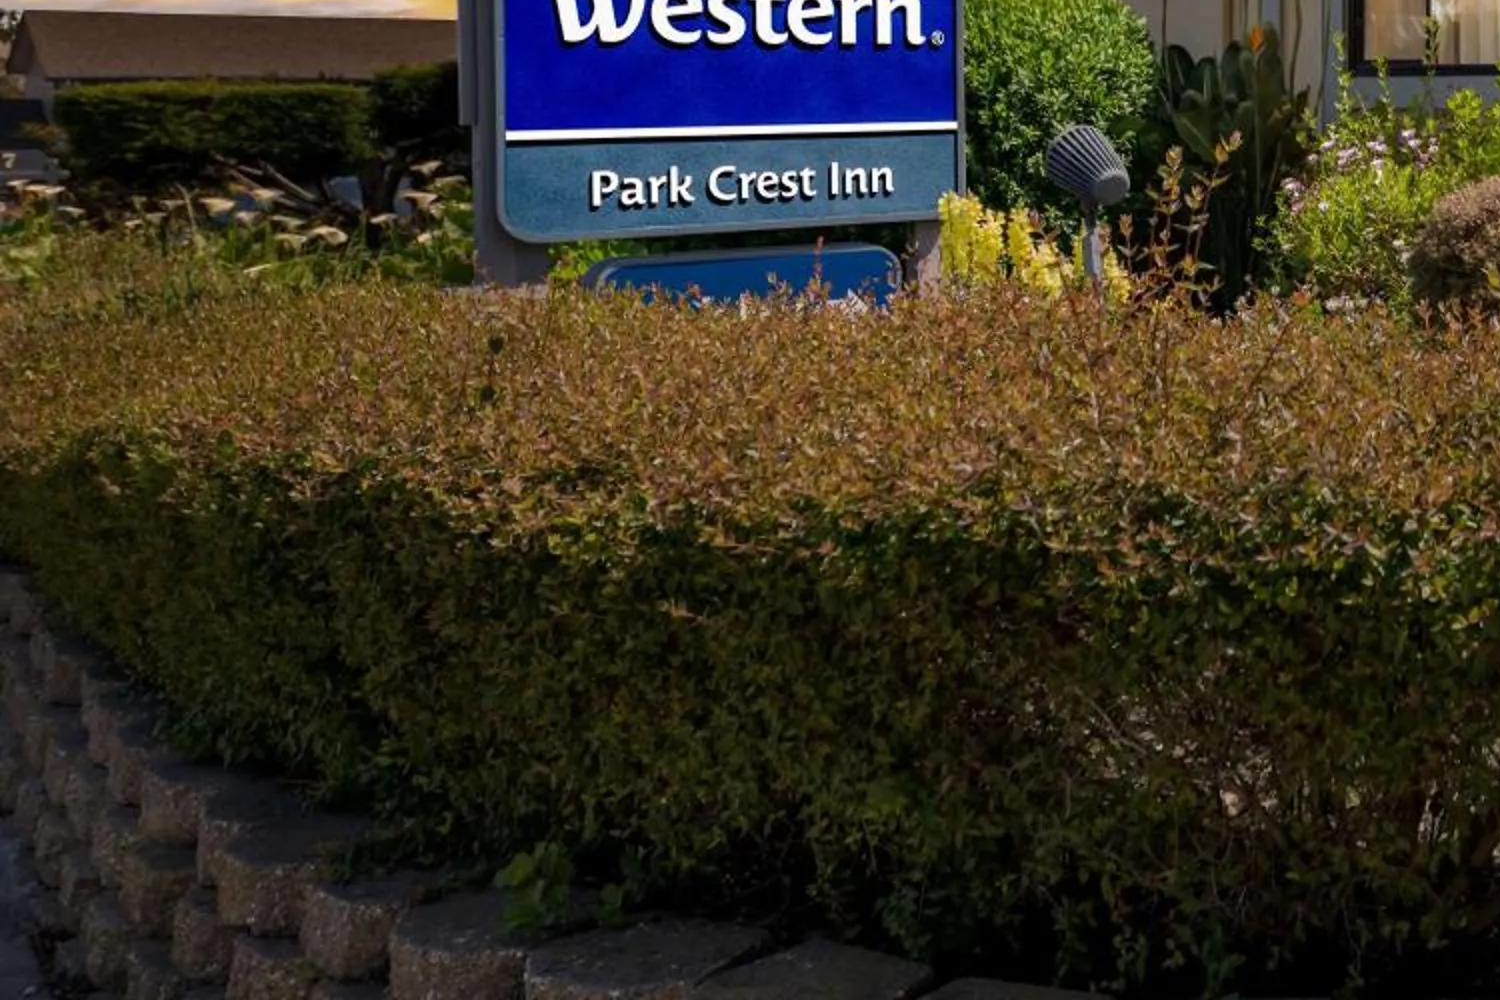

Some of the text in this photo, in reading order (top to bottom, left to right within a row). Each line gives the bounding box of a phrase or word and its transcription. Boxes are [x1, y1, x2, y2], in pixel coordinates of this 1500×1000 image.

[590, 161, 896, 207] Park Crest Inn
